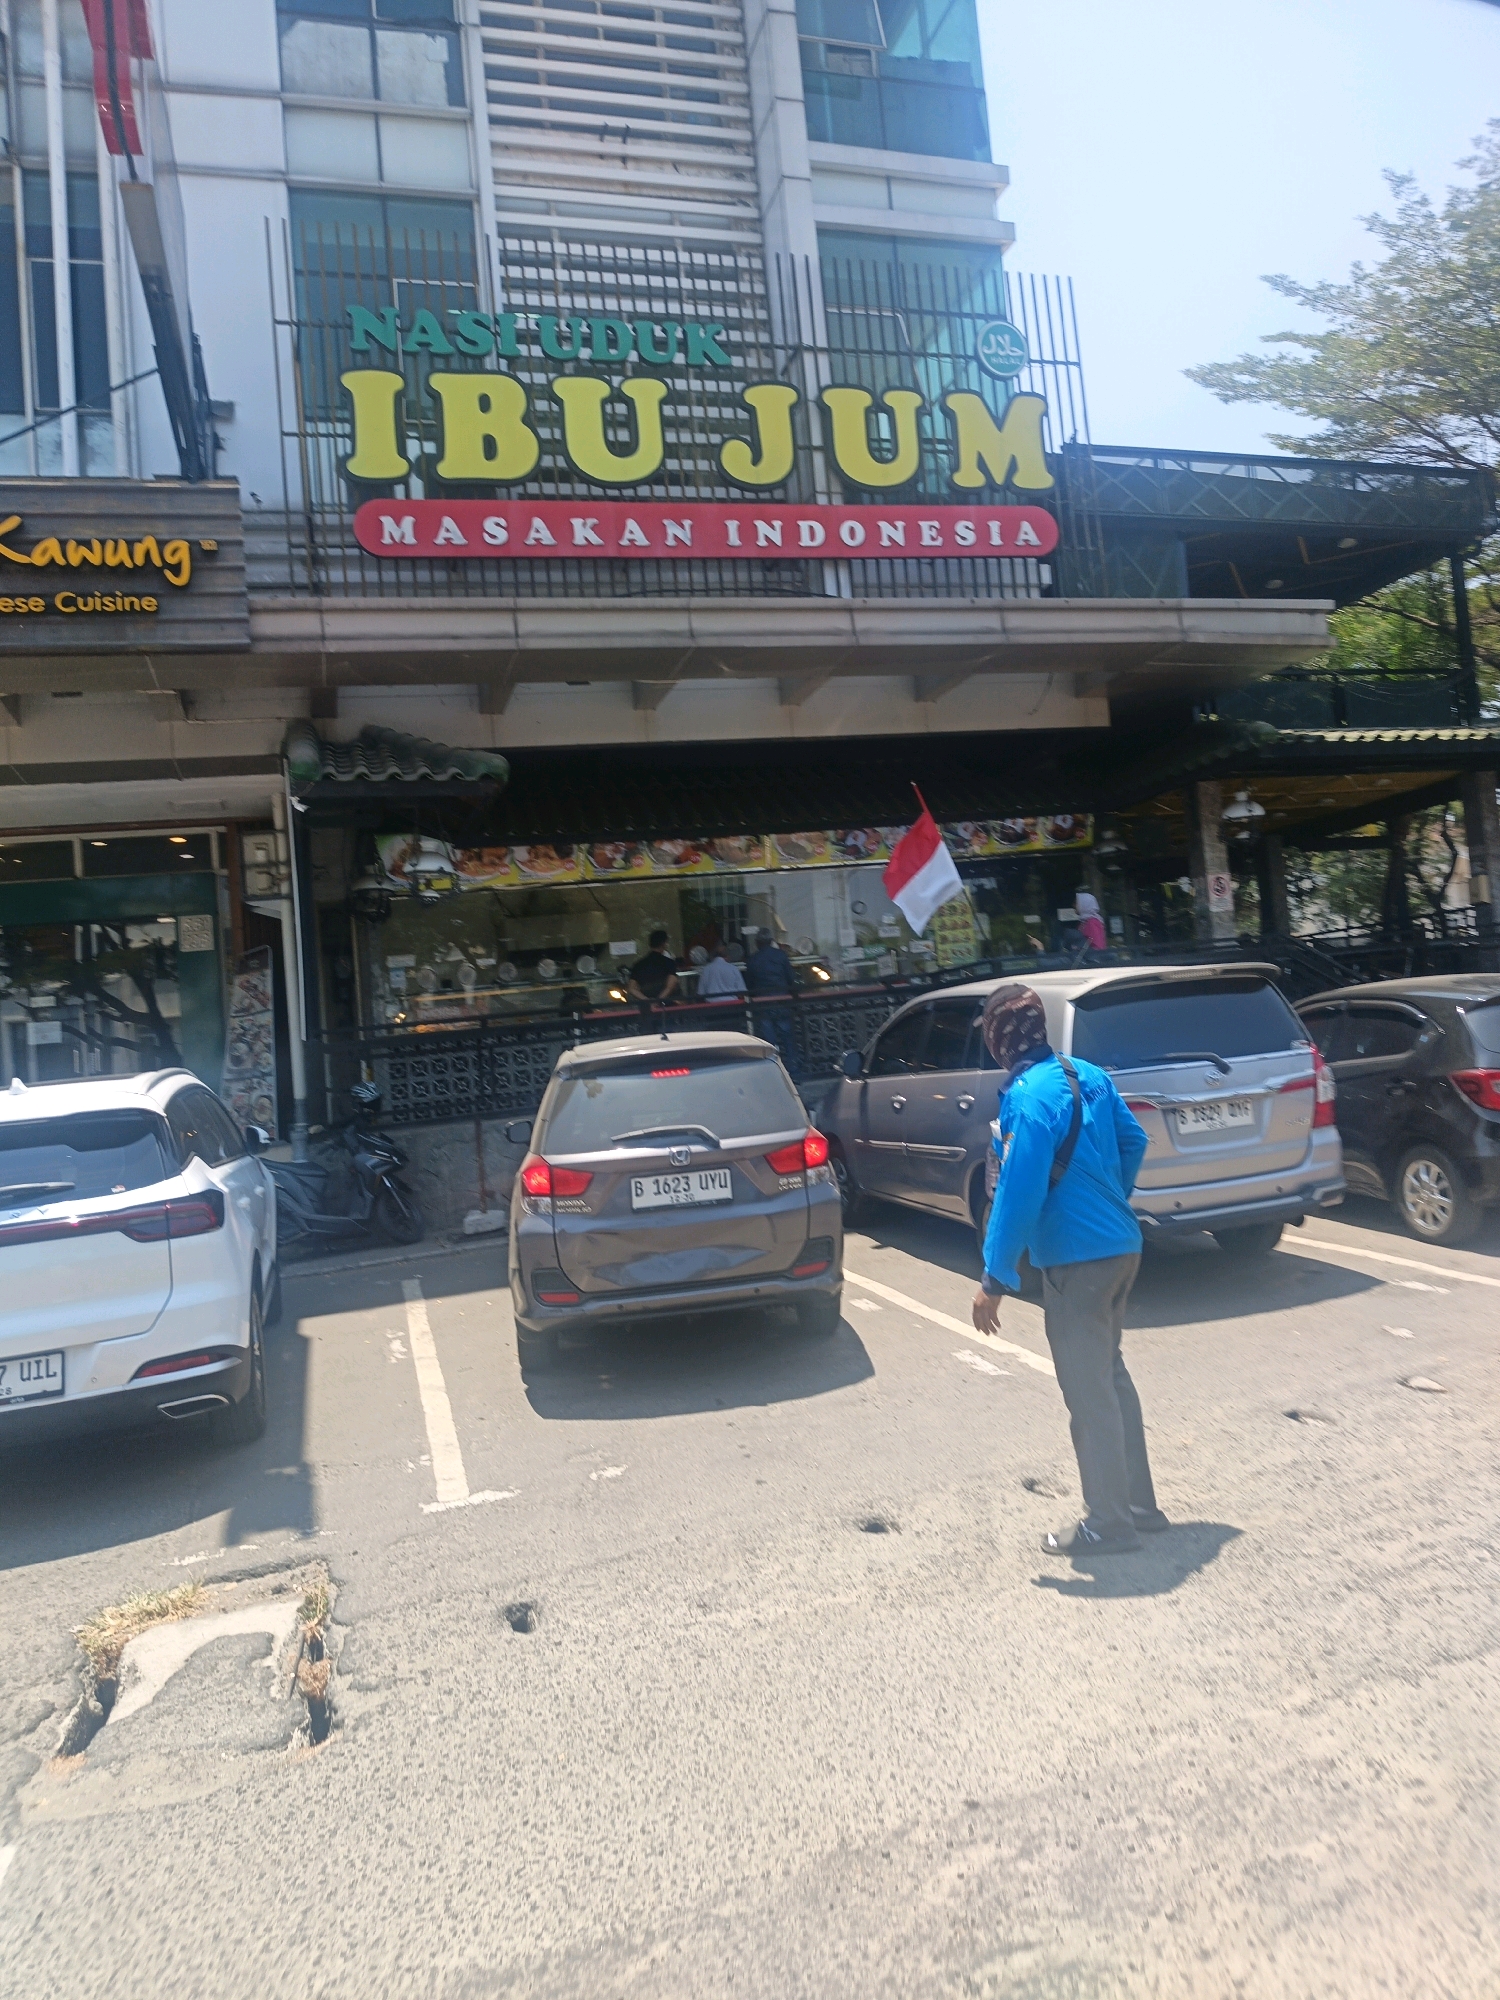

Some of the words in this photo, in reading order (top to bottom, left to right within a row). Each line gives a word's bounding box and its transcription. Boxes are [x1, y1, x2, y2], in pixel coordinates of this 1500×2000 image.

[346, 305, 521, 357] NASI
[537, 315, 732, 366] UDUK
[339, 368, 669, 484] IBU
[719, 383, 1056, 490] JUM
[378, 515, 694, 547] MASAKAN
[723, 519, 1043, 548] INDONESIA
[54, 590, 159, 613] Cuisine
[634, 1180, 644, 1198] B
[652, 1176, 691, 1197] 1623
[699, 1171, 728, 1191] UYU
[20, 1357, 57, 1382] UIL
